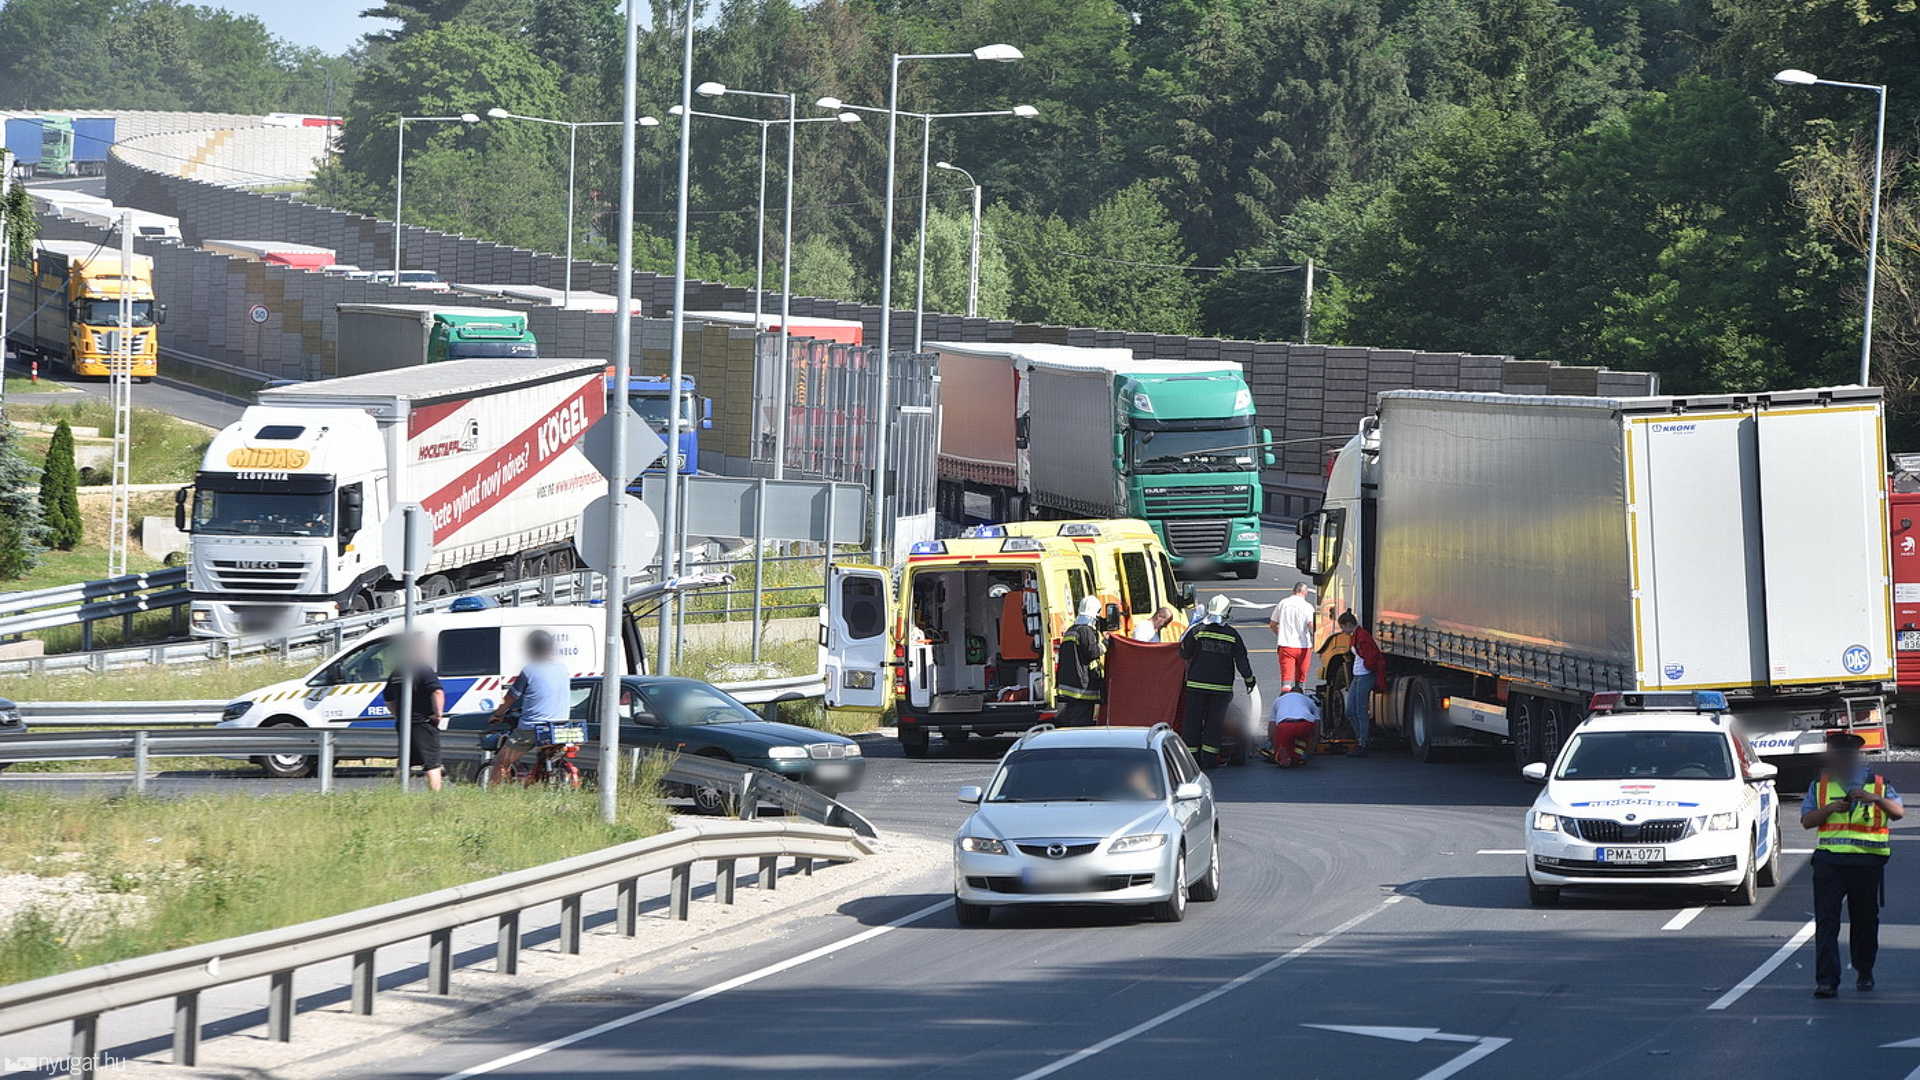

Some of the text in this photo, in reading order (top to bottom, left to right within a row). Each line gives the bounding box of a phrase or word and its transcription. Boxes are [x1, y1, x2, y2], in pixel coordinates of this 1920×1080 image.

[231, 448, 306, 470] MIDAS
[236, 472, 289, 480] SLOVAKIA
[236, 560, 280, 569] IVECO
[1845, 650, 1869, 669] DAS
[367, 706, 392, 716] REN
[1606, 848, 1661, 860] PMA-077
